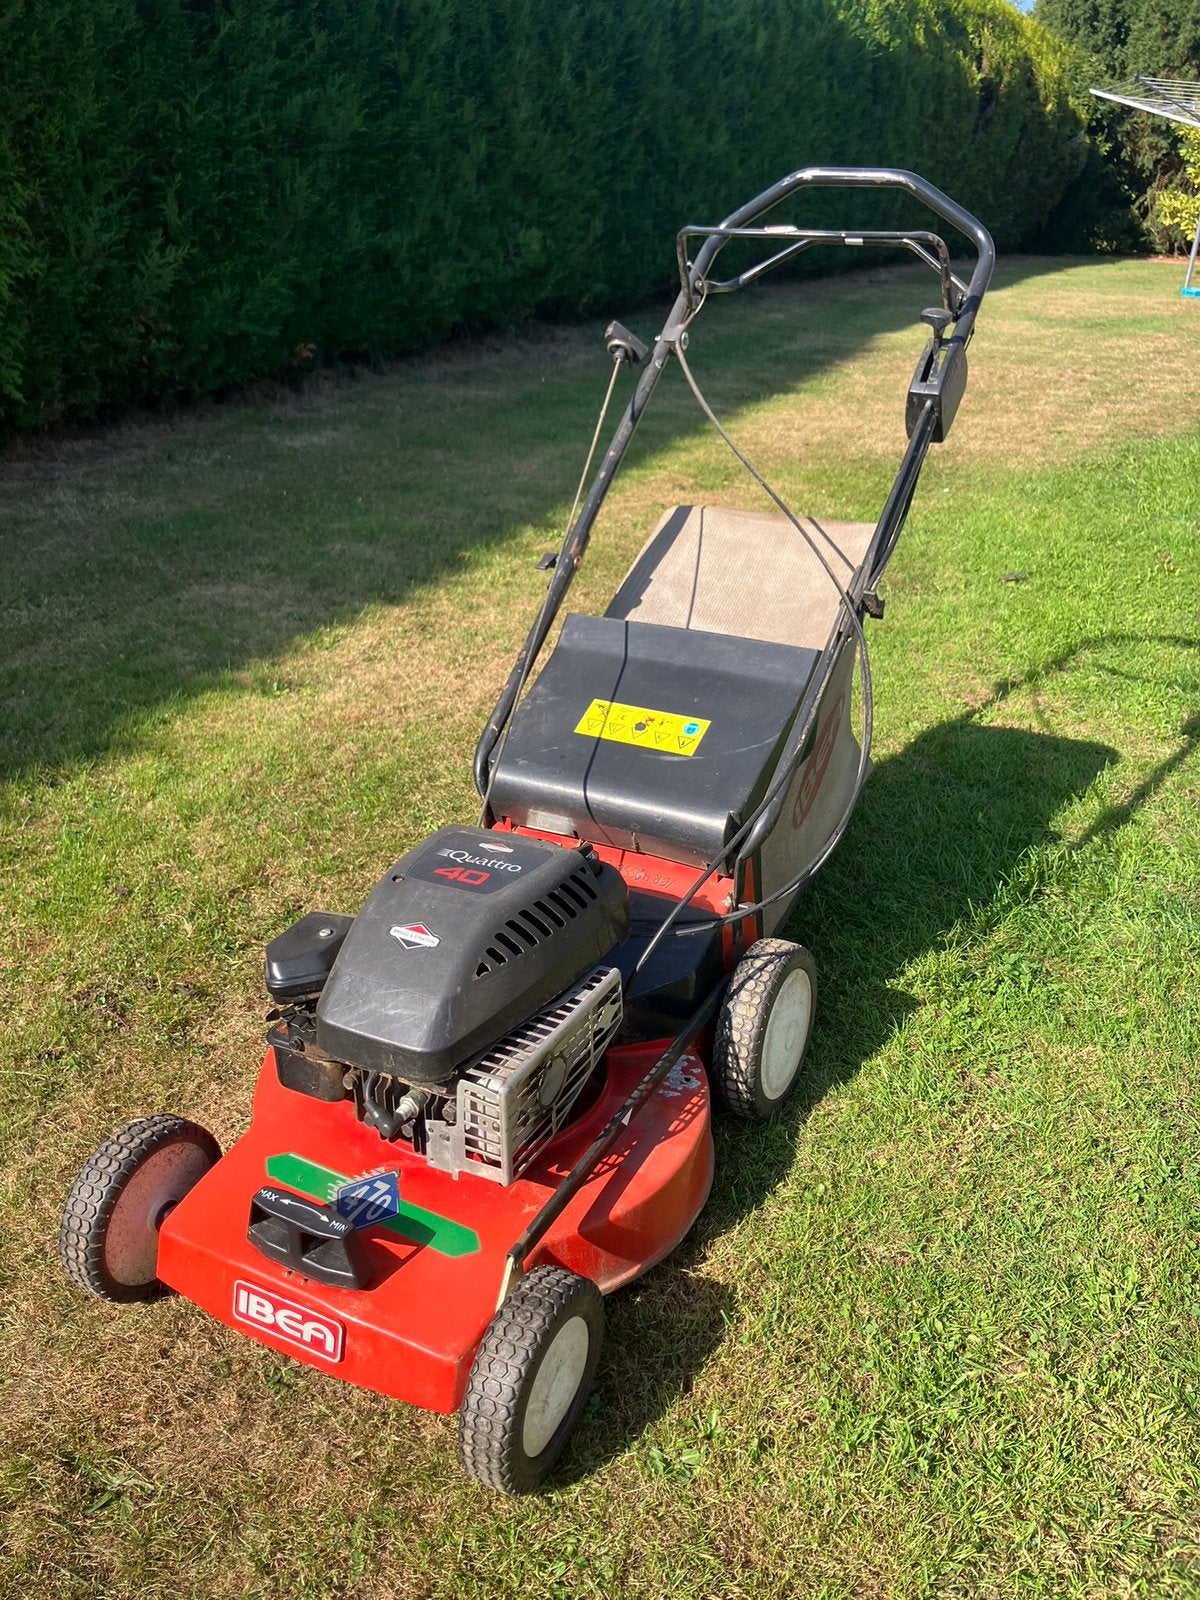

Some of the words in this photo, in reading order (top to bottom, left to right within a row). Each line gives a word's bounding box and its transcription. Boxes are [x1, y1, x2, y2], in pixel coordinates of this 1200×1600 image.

[448, 850, 522, 872] Quattro
[433, 867, 491, 885] 40
[259, 1189, 280, 1202] MAX
[345, 1180, 392, 1221] 470
[329, 1220, 350, 1233] MIN
[238, 1289, 335, 1353] IBEA
